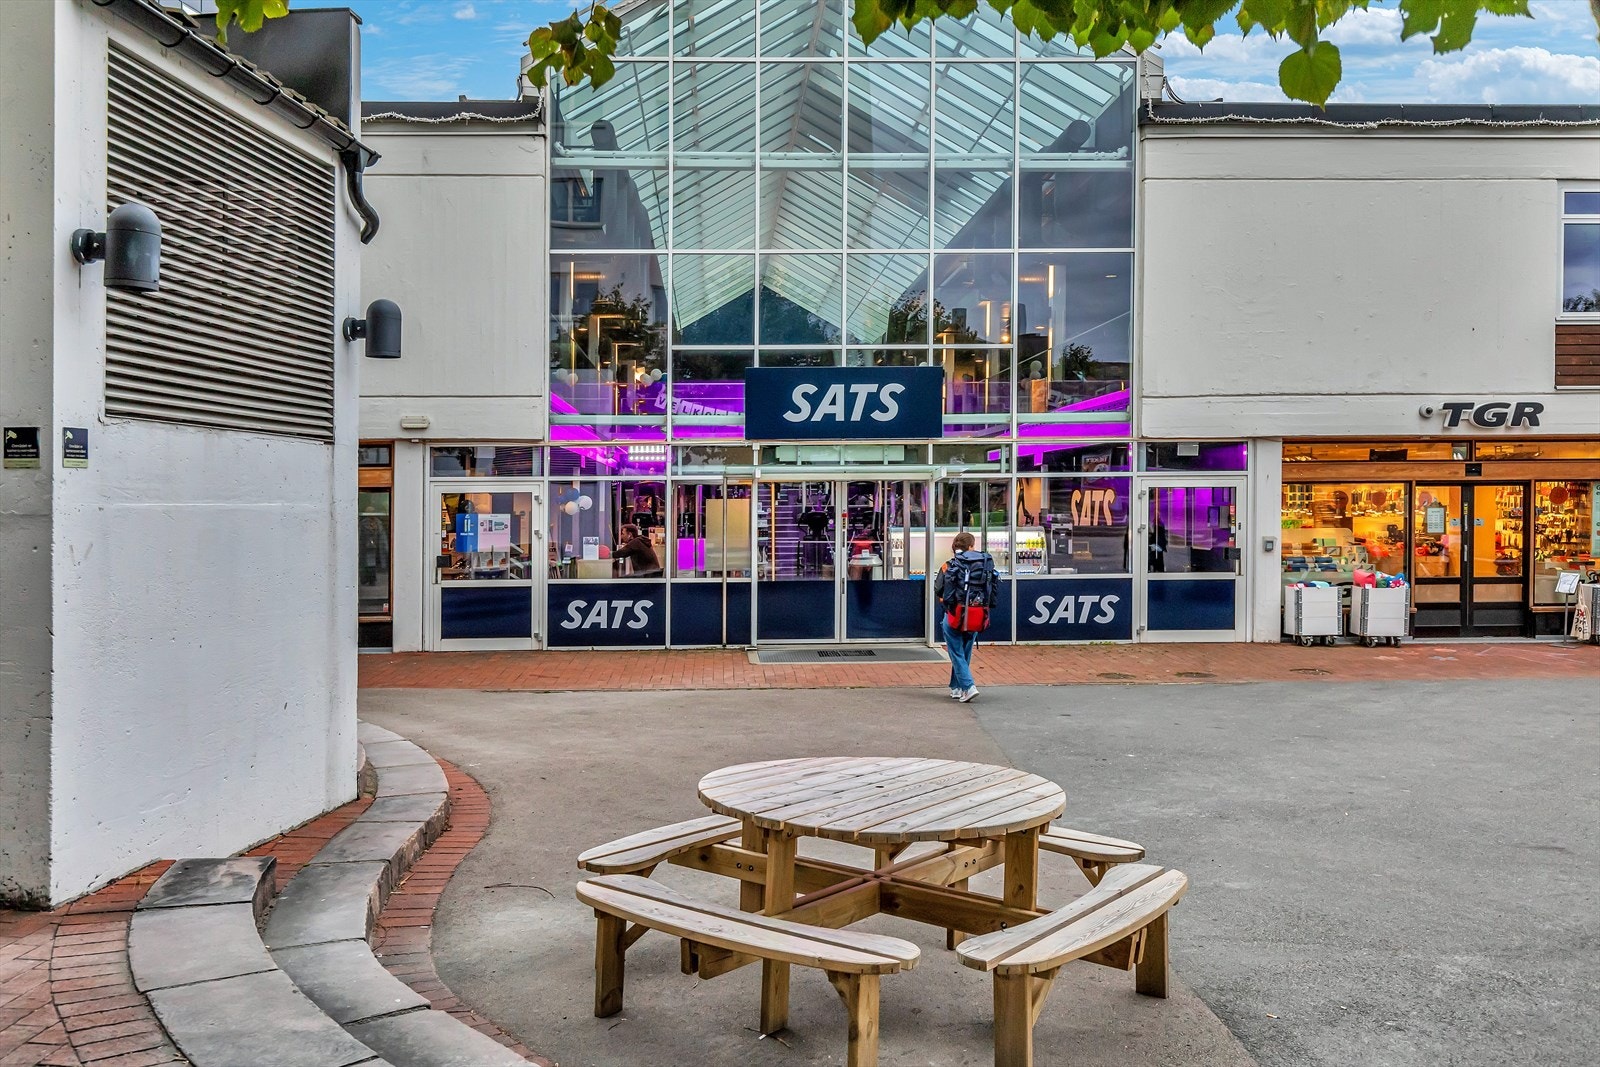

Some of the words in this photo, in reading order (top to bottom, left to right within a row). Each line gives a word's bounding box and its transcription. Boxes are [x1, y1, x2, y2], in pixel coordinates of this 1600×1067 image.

[783, 383, 905, 422] SATS
[1442, 402, 1545, 428] TGR
[561, 600, 653, 629] SATS
[1029, 595, 1120, 624] SATS
